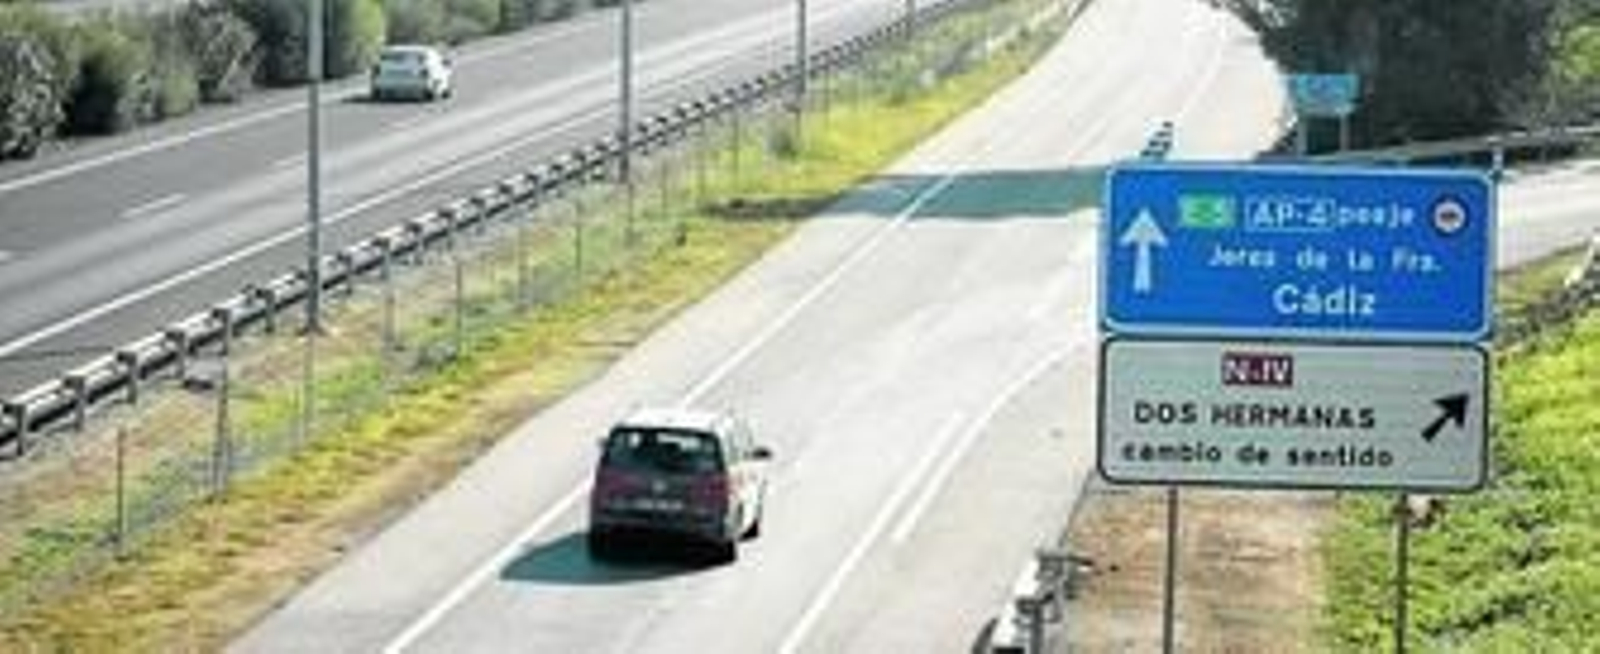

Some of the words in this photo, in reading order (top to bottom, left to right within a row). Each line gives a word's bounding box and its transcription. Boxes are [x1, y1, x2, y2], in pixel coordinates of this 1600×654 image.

[1296, 247, 1328, 270] de
[1349, 249, 1374, 271] la
[1272, 282, 1376, 317] Cádiz
[1225, 357, 1292, 384] N-IV
[1133, 402, 1198, 426] DOS
[1211, 404, 1376, 430] HERMANAS
[1121, 442, 1222, 464] cambio
[1236, 446, 1271, 466] de
[1287, 446, 1394, 468] sentido
